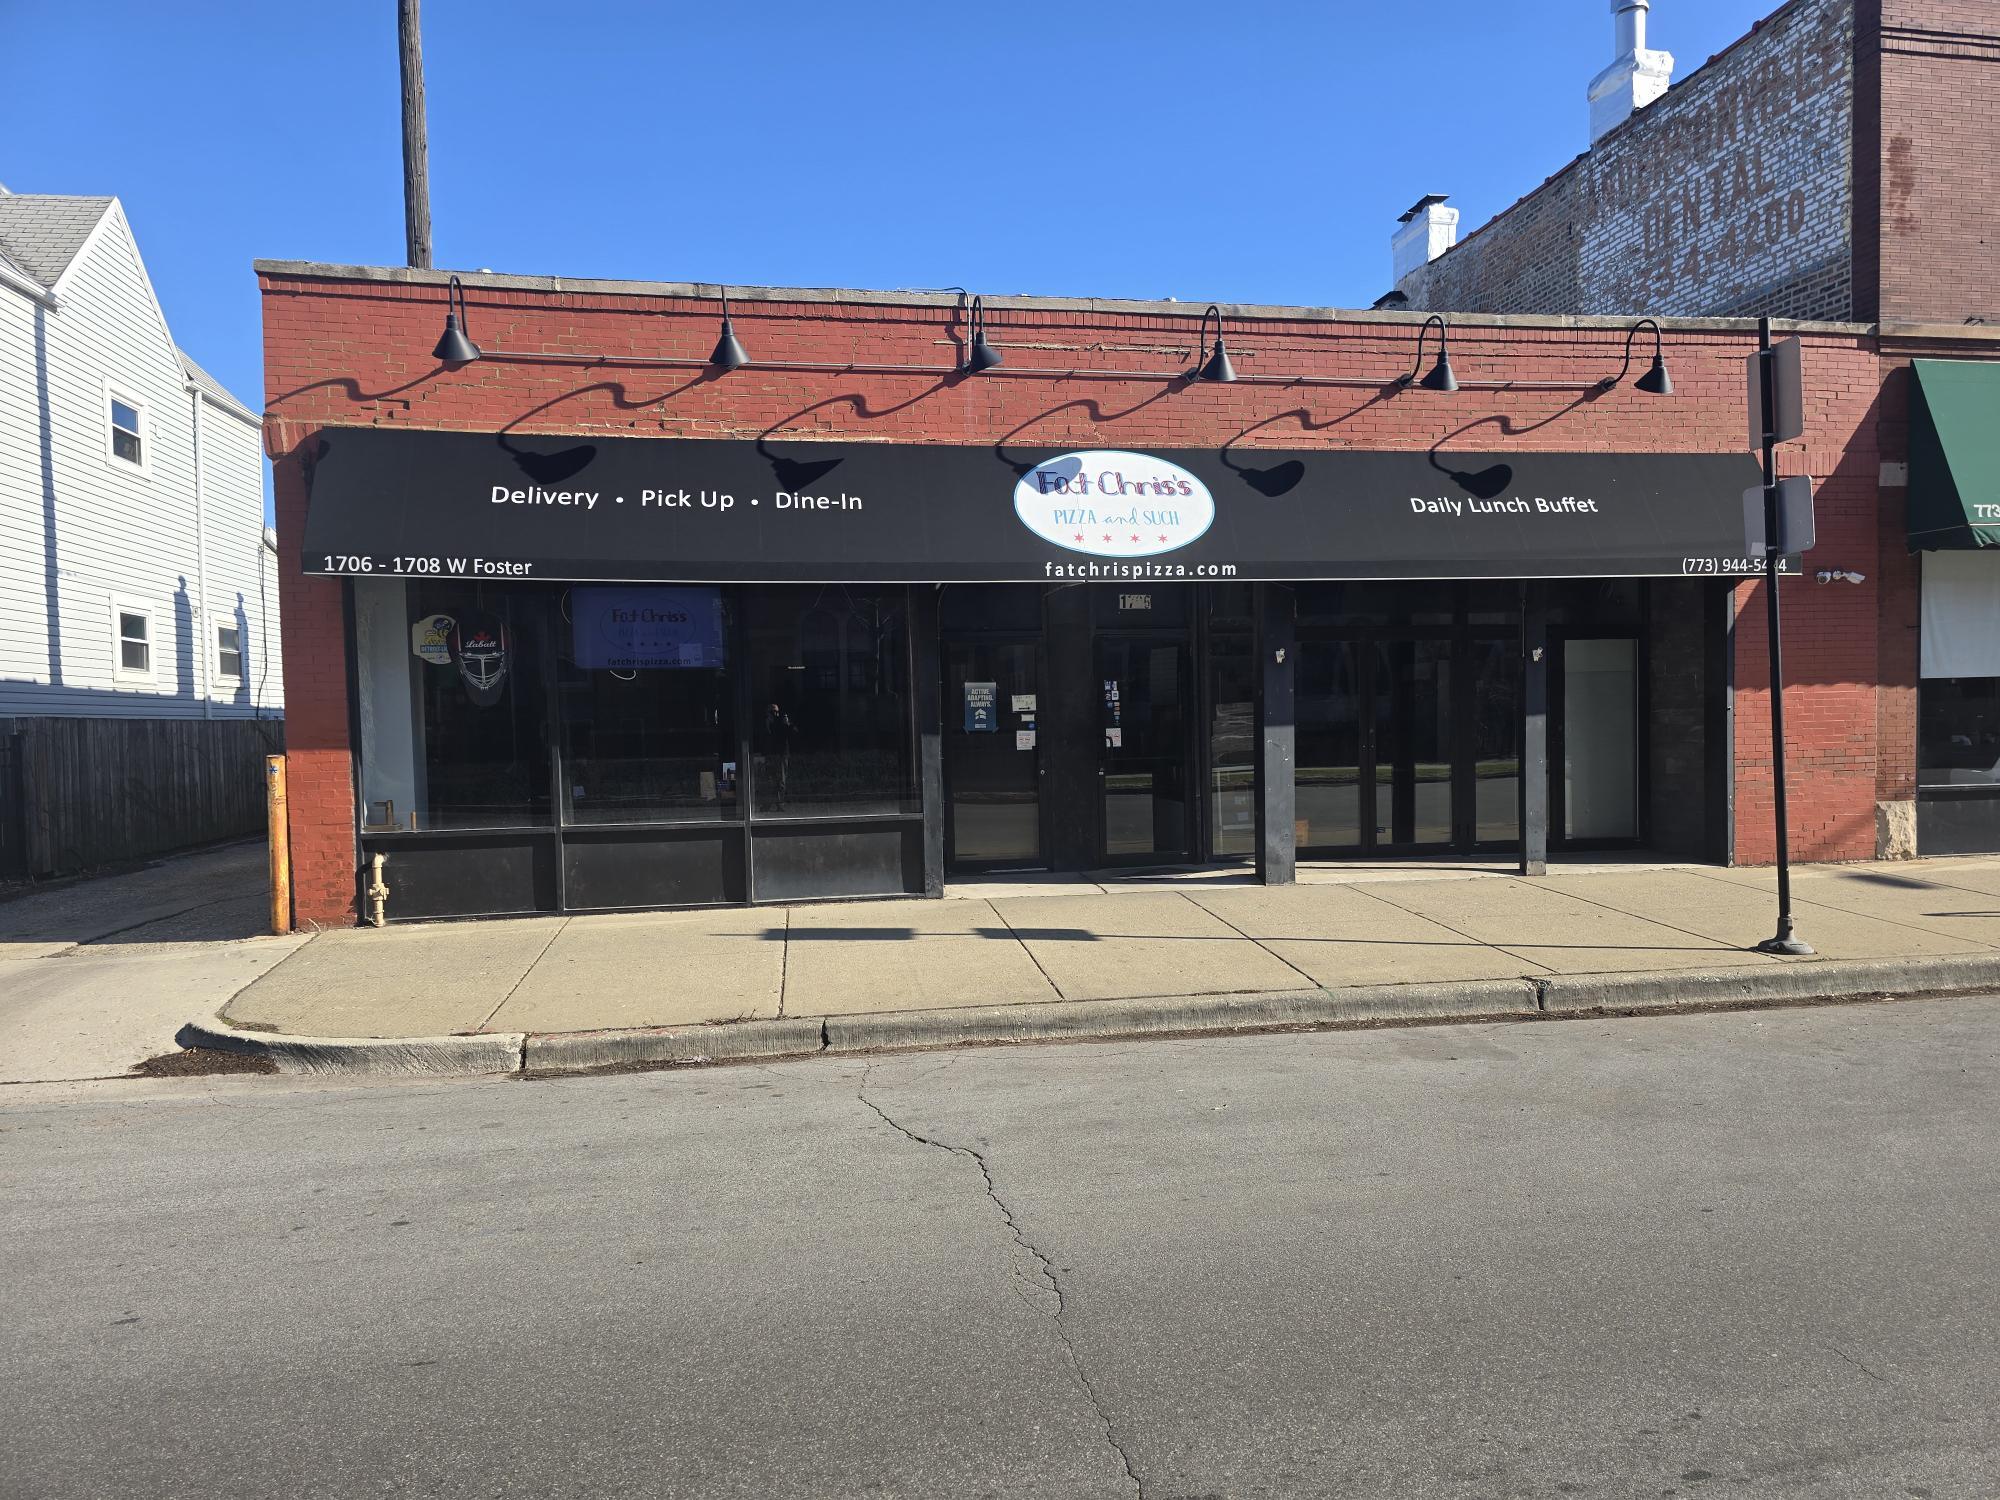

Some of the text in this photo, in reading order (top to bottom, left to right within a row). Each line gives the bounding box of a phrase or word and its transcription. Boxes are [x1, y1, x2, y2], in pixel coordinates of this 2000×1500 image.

[1036, 470, 1194, 496] Fat Chris's
[491, 485, 863, 512] Delivery Pick Up Dine-In
[1410, 496, 1599, 517] Daily Lunch Buffet
[1053, 507, 1180, 527] PIZZA and SUCH
[324, 555, 373, 572] 1706
[392, 556, 441, 574] 1708
[446, 558, 467, 574] W
[474, 558, 533, 575] Foster
[1045, 561, 1237, 580] fatchrispizza.com
[1681, 557, 1787, 574] (773) 944-544
[465, 640, 497, 649] Labatt
[608, 657, 691, 667] fatchrispizza.com
